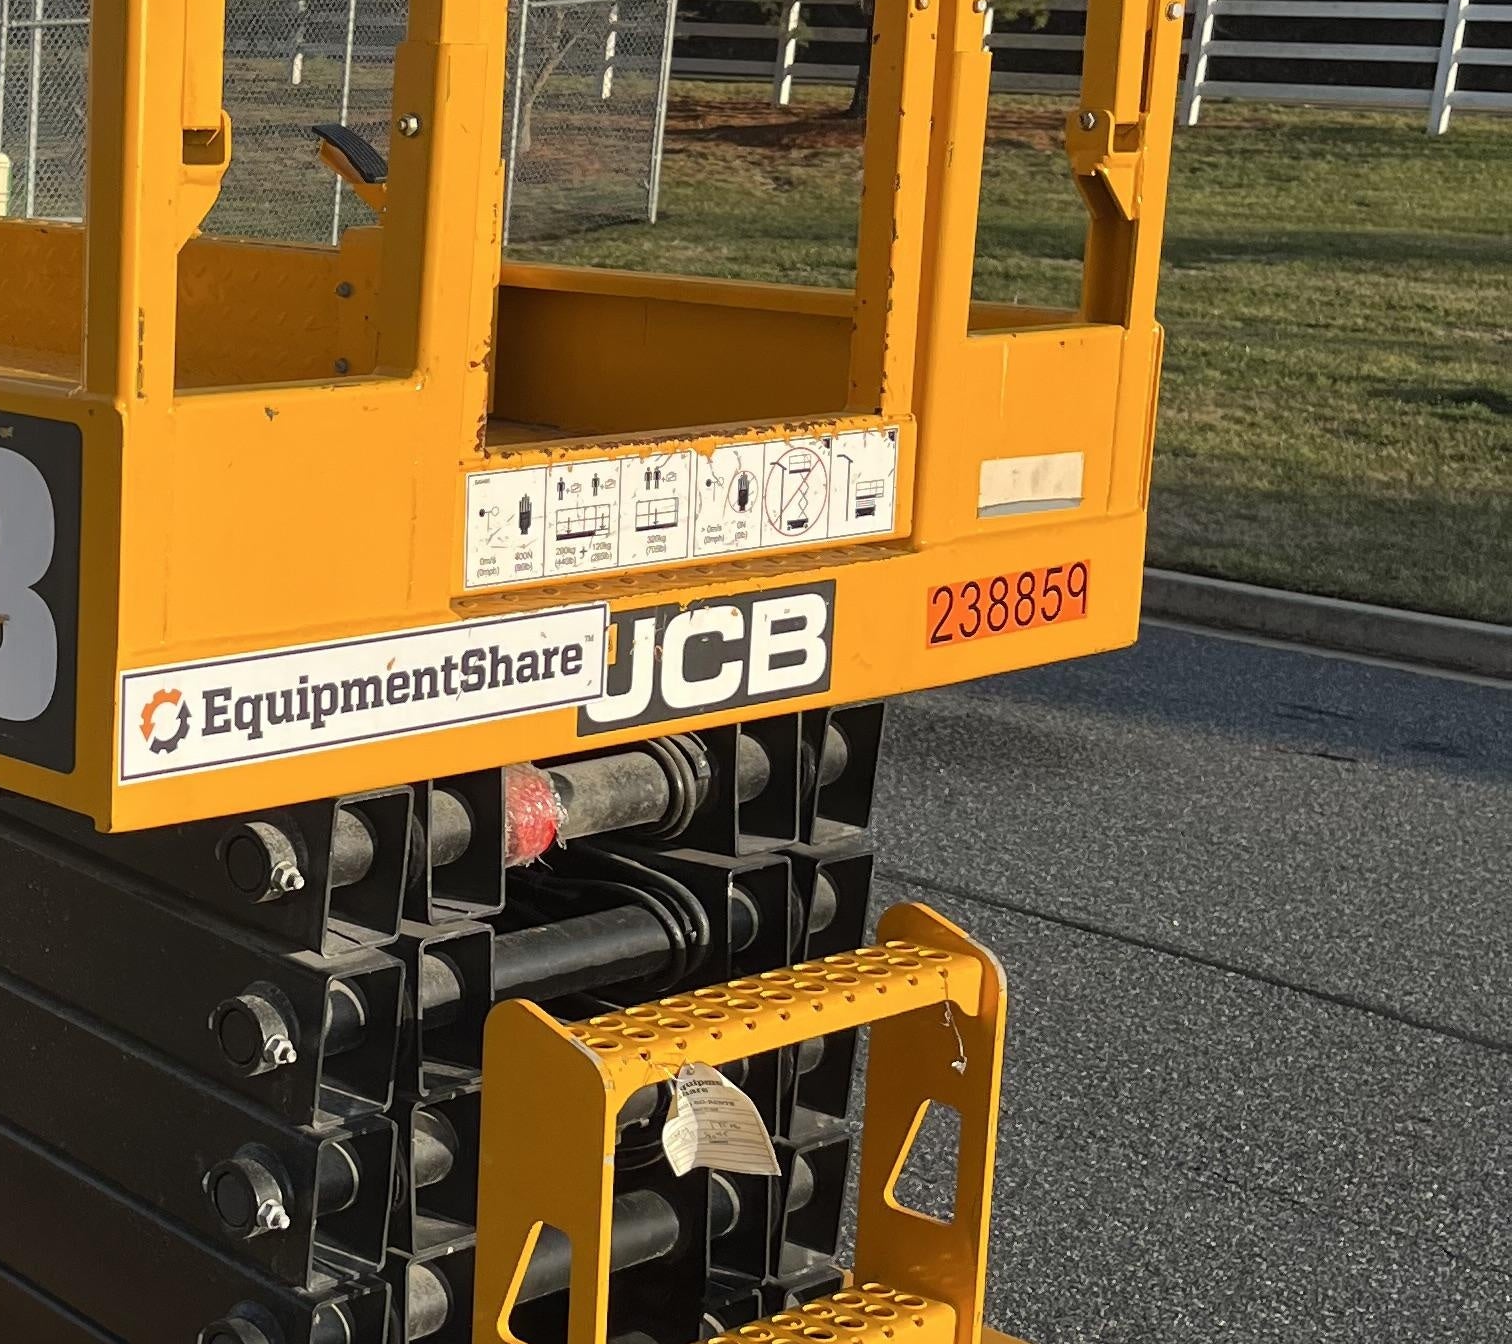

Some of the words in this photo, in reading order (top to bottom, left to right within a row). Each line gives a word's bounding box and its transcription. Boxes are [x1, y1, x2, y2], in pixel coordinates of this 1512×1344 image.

[930, 561, 1088, 644] 238859
[201, 641, 584, 739] EquipmentShare
[586, 593, 828, 723] JCB
